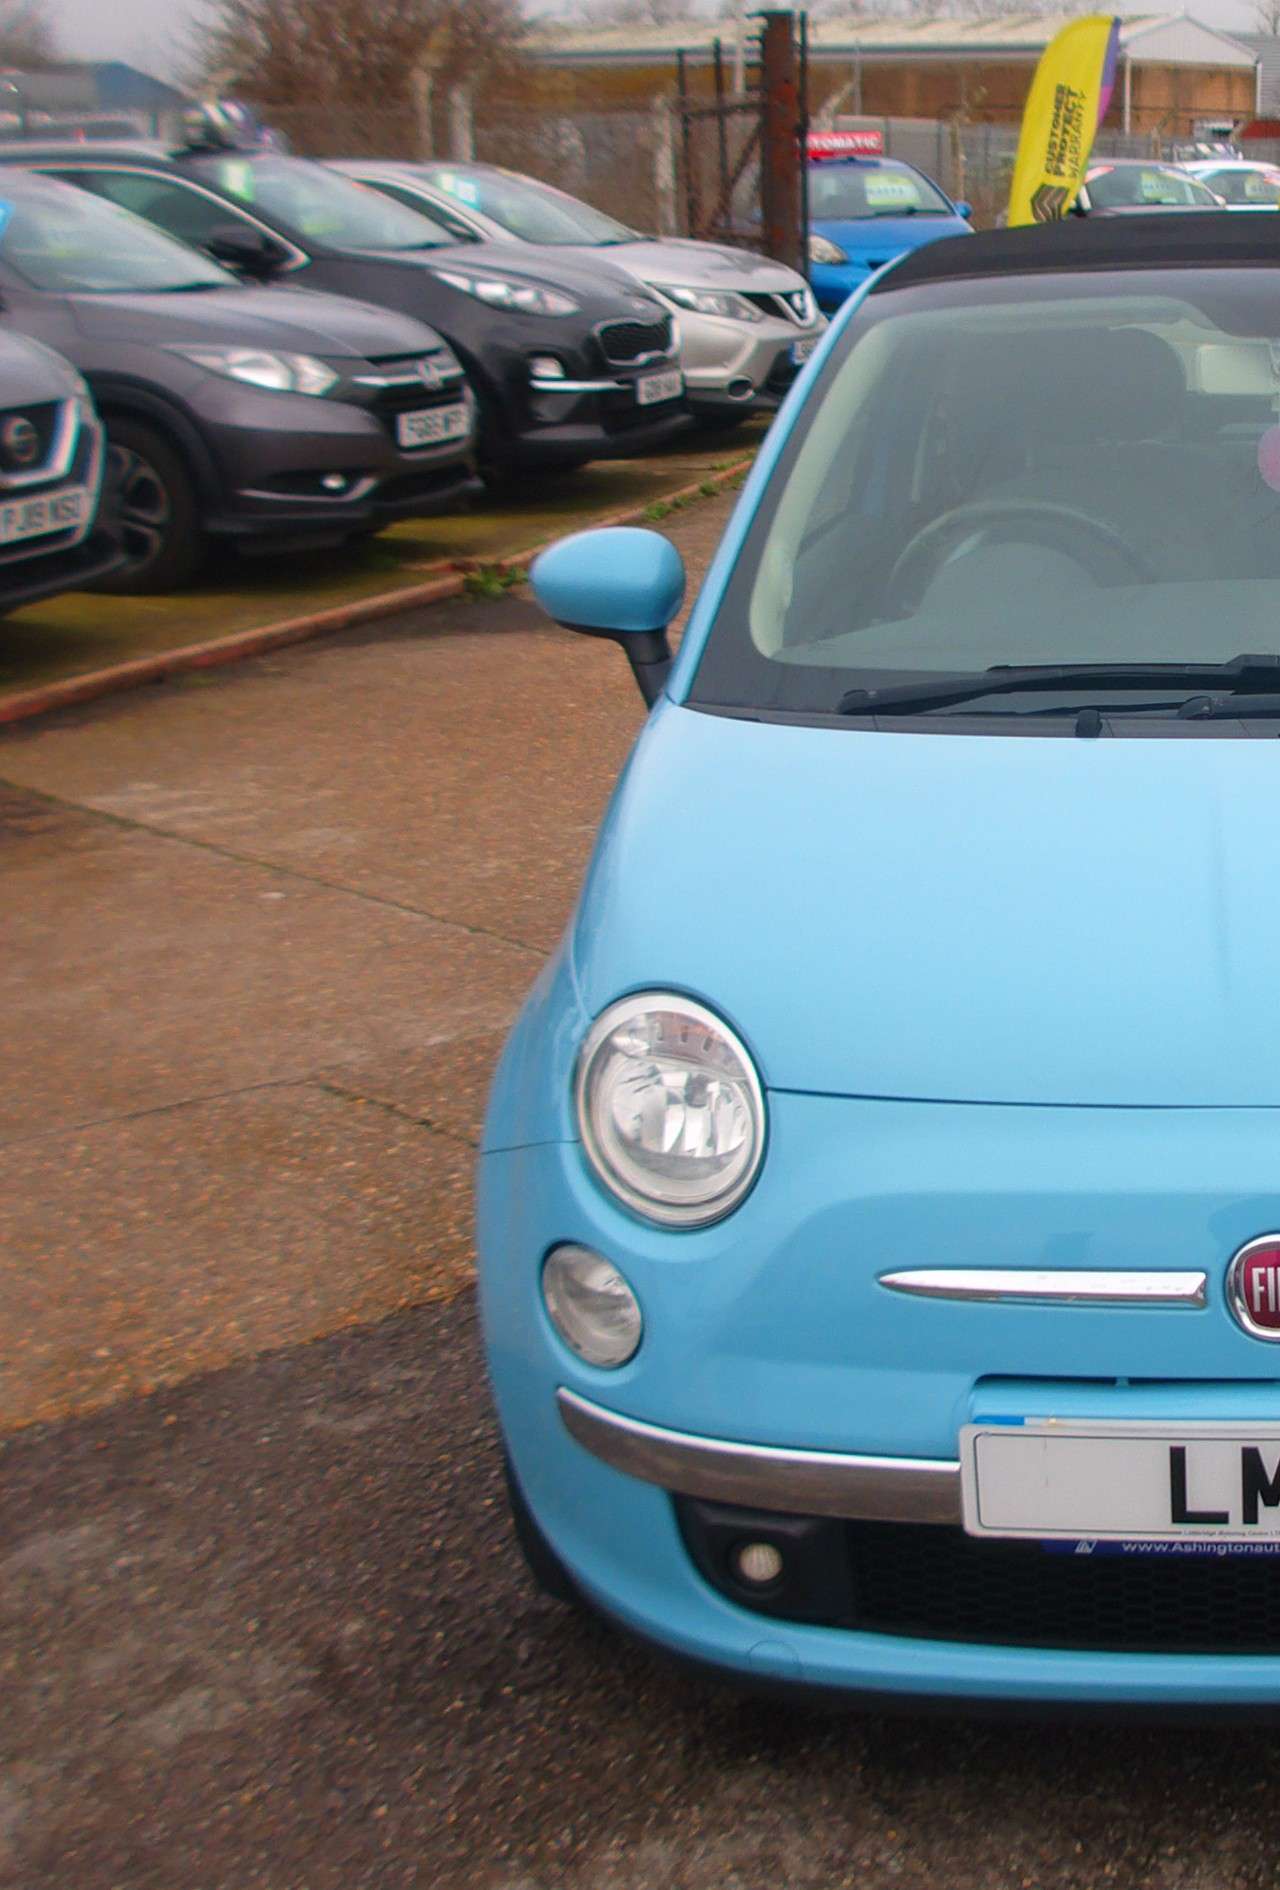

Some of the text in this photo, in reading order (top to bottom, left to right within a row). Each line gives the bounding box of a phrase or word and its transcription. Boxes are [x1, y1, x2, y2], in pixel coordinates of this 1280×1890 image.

[811, 136, 879, 149] TOMATIC
[1053, 85, 1078, 177] PROTECT
[1069, 90, 1087, 178] WARRANTY
